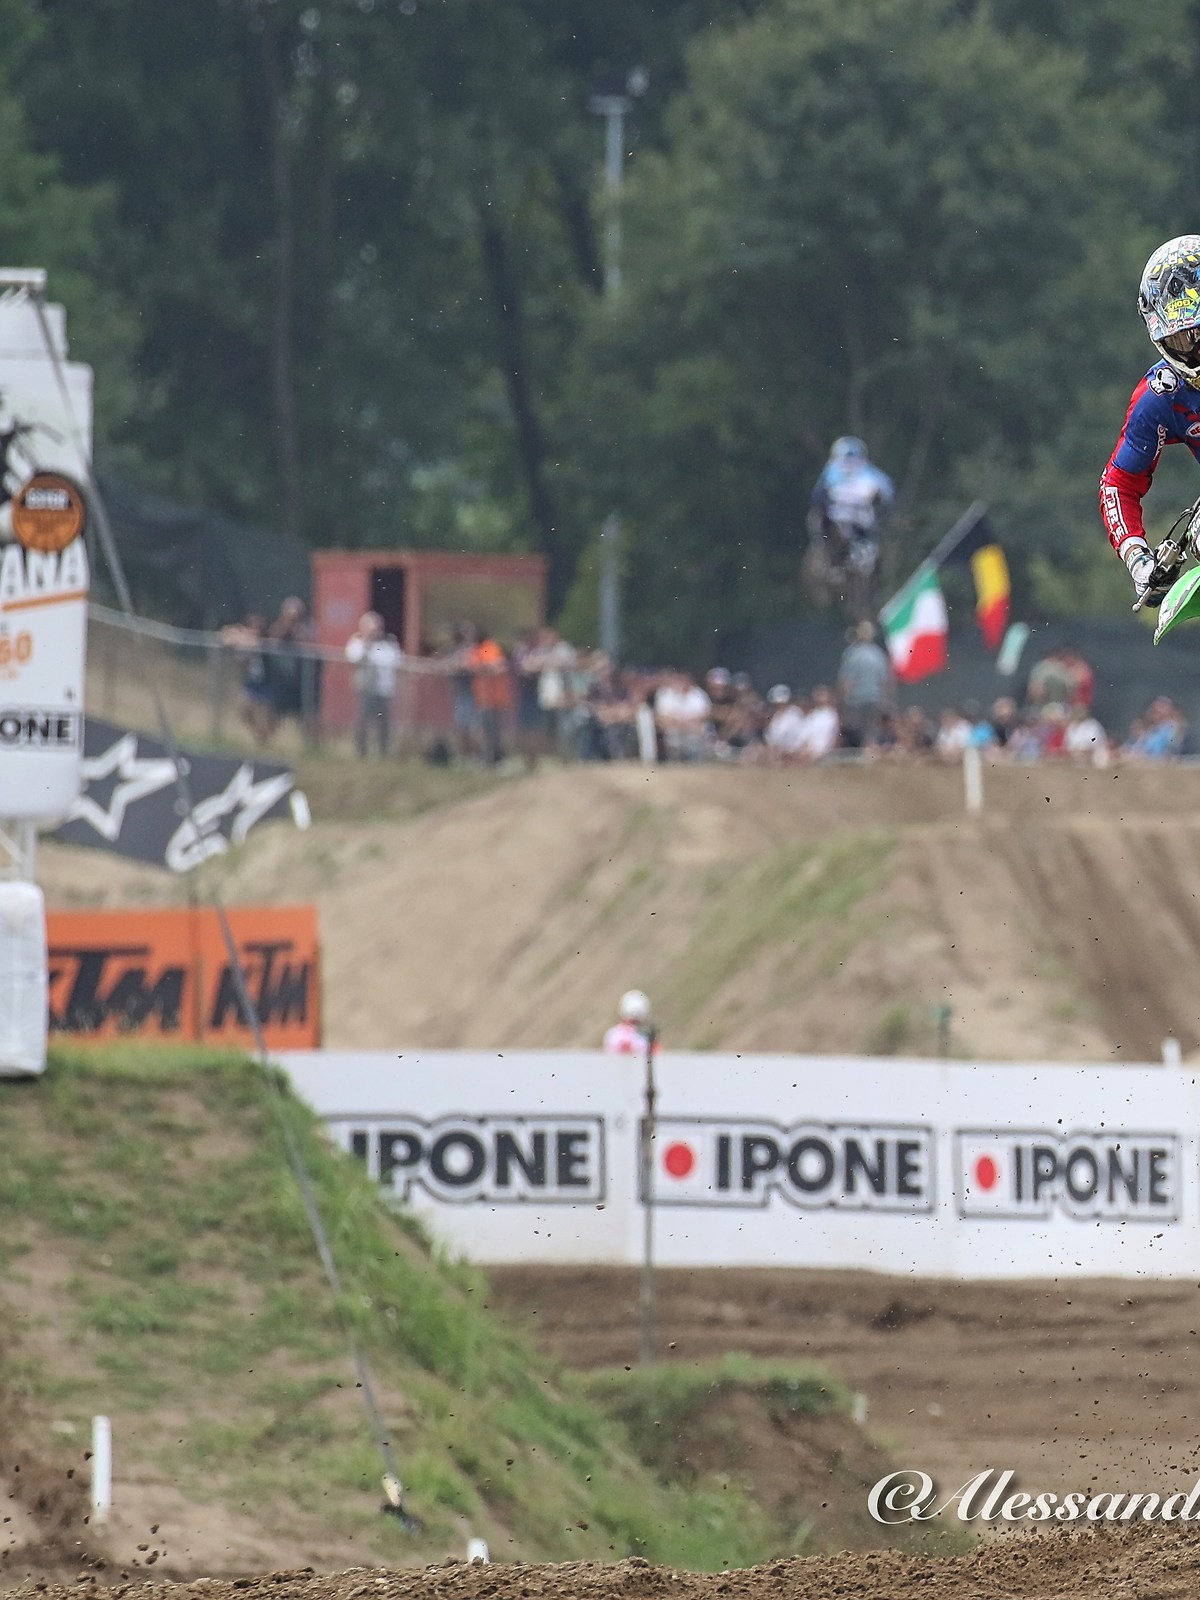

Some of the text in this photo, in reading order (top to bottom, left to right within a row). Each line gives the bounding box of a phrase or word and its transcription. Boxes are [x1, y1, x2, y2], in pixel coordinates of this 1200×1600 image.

[48, 943, 187, 1036] TM
[211, 940, 309, 1030] KTM
[716, 1135, 921, 1196] IPONE
[1014, 1146, 1169, 1205] IPONE
